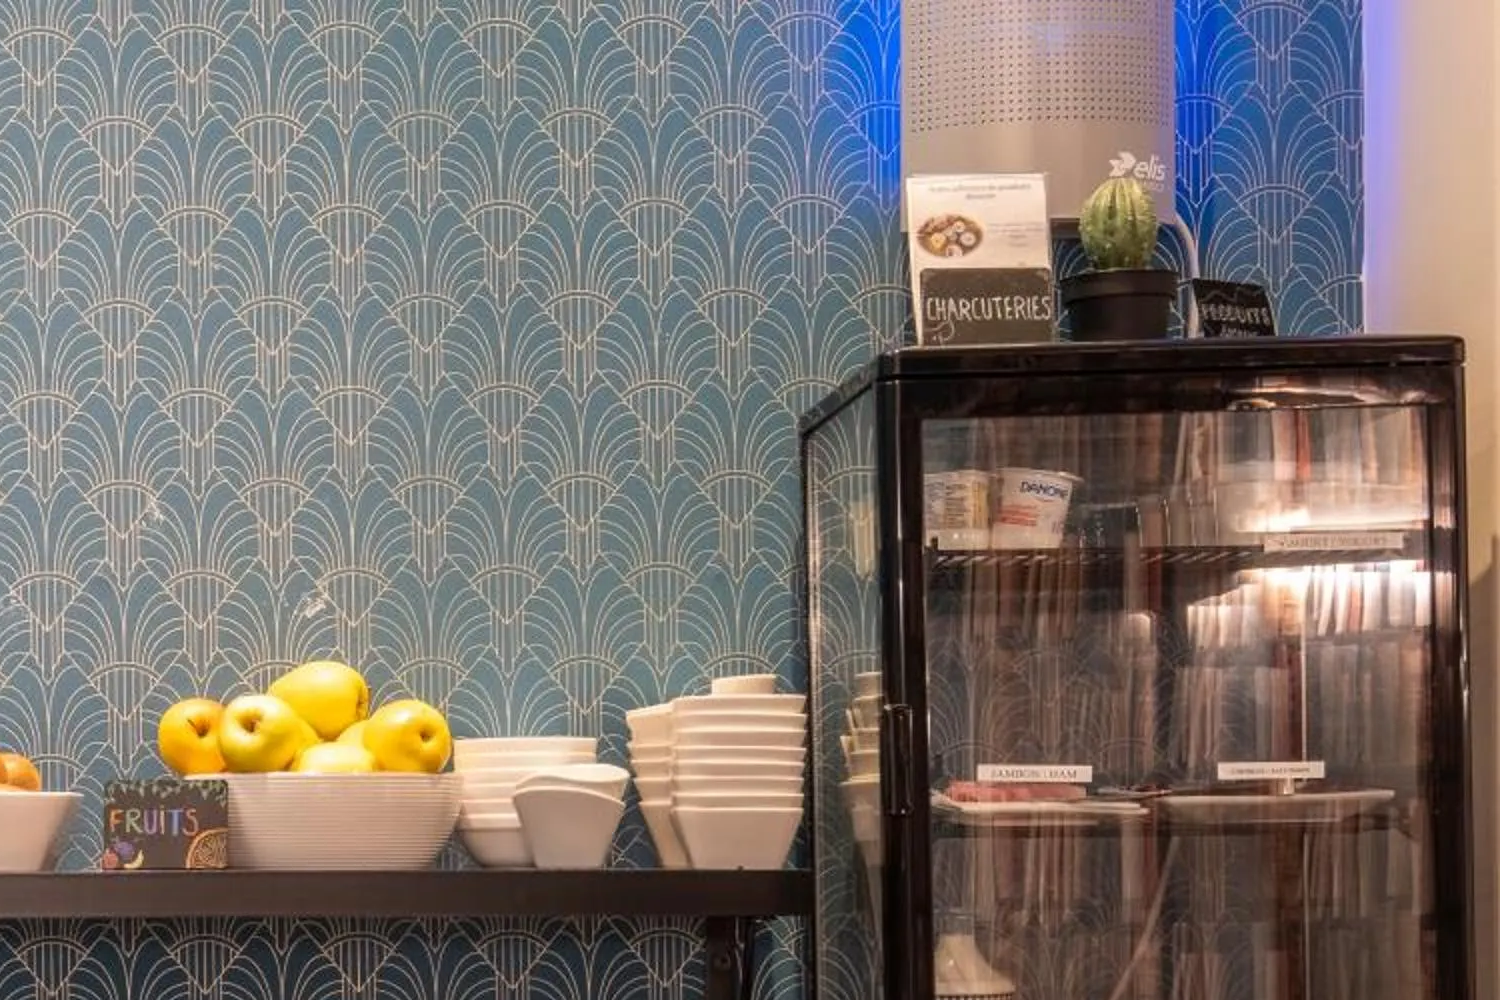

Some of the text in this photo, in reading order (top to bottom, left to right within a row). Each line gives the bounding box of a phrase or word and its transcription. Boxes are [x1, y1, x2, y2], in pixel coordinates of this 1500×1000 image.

[1133, 153, 1166, 180] elis
[927, 295, 1052, 321] CHARCUTERIES
[1201, 304, 1271, 326] PRODUITS
